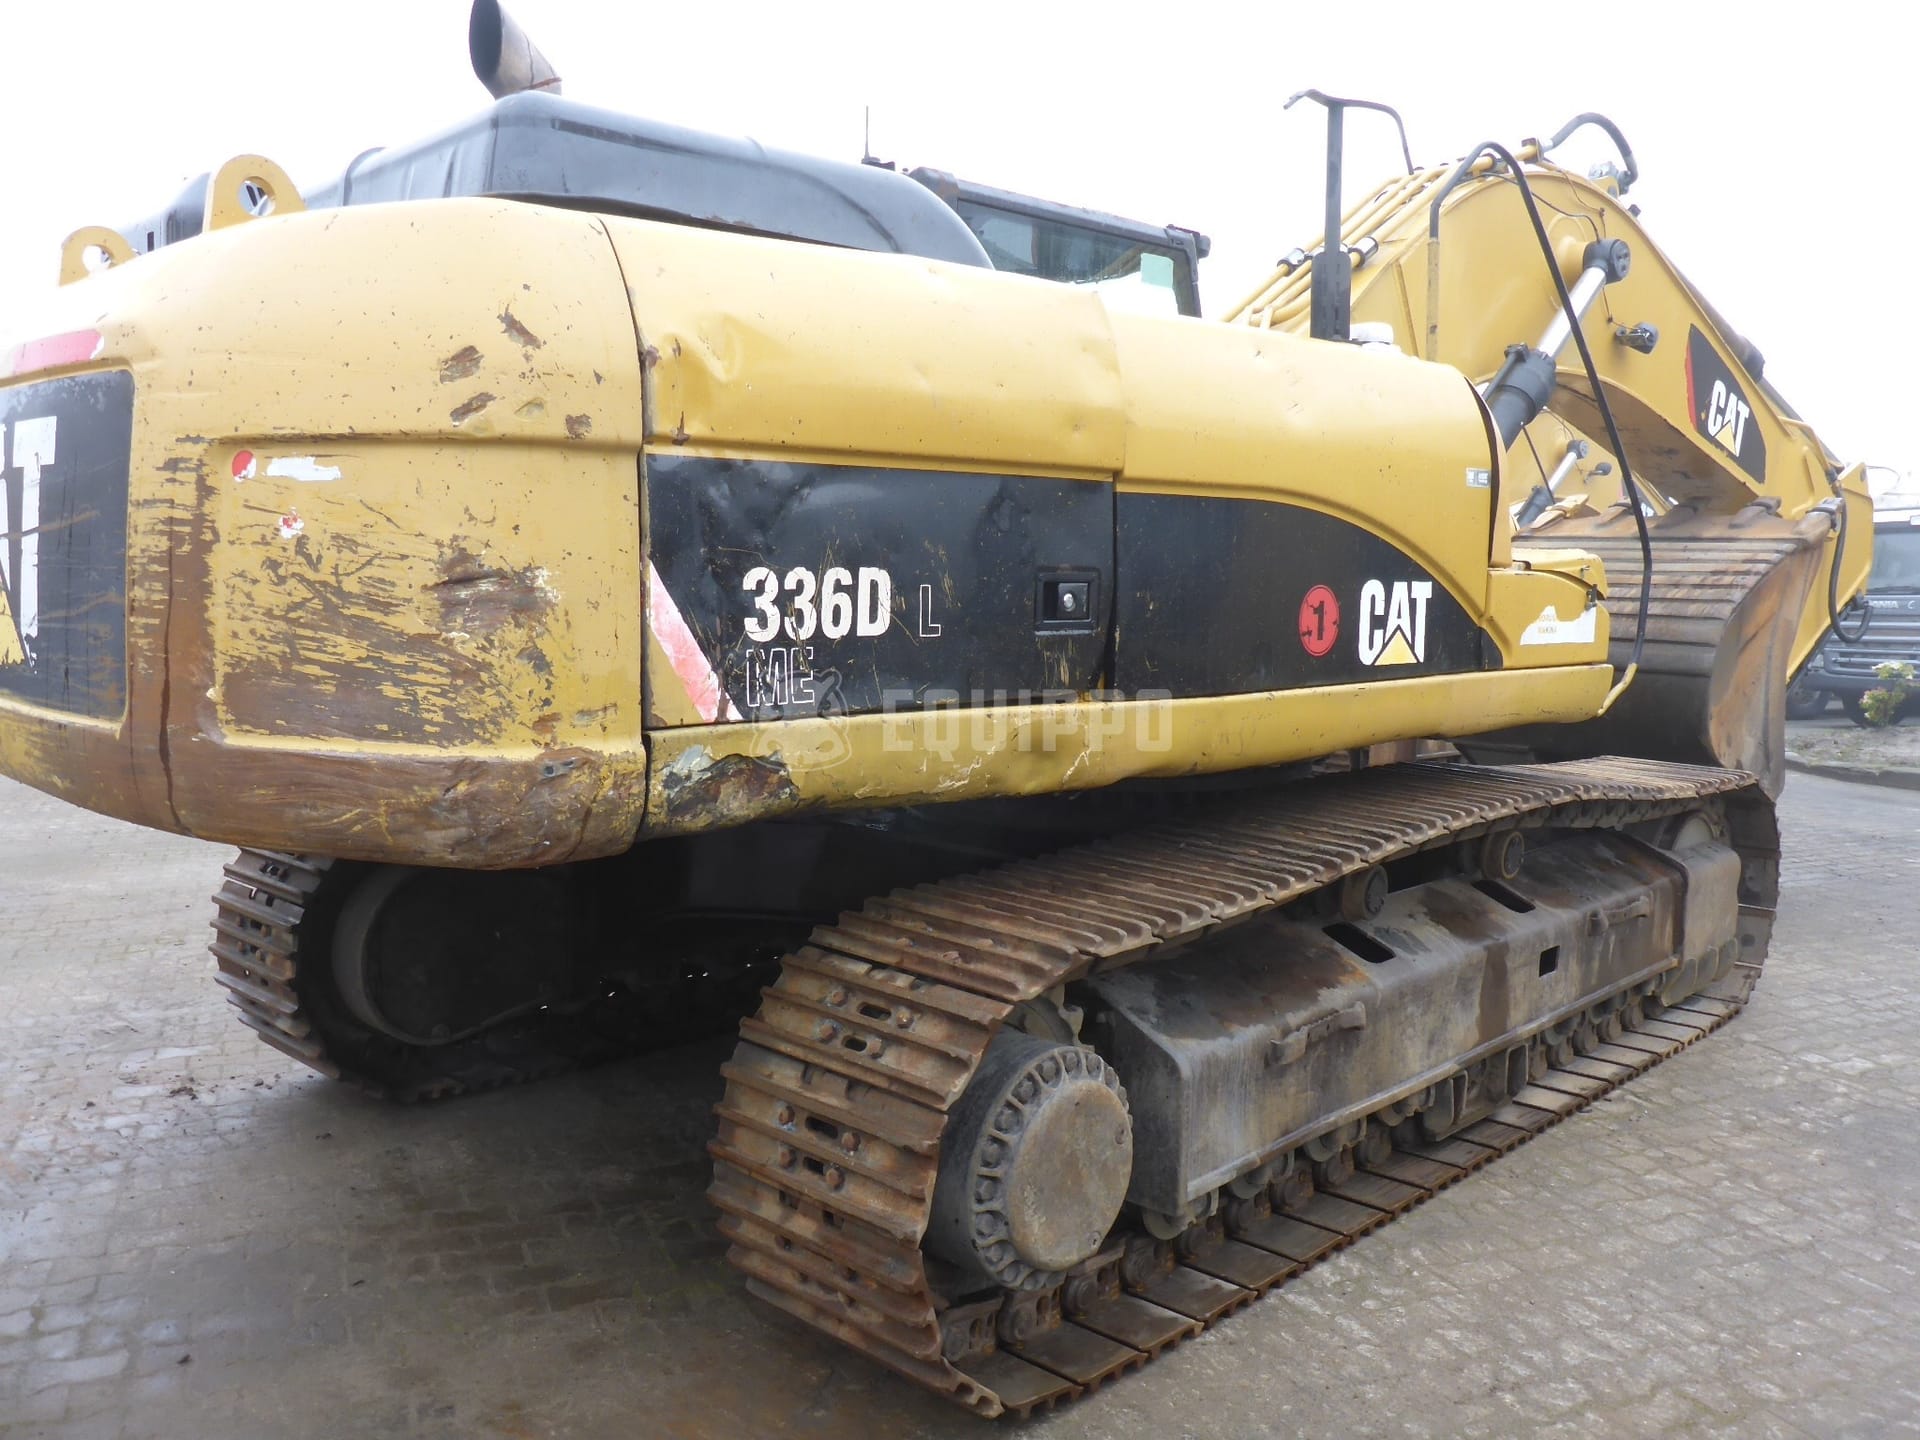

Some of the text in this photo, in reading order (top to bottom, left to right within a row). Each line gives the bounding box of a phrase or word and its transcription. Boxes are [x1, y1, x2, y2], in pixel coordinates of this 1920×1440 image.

[1708, 379, 1750, 457] CAT
[0, 415, 57, 668] T
[743, 566, 942, 643] 336D L
[1358, 579, 1433, 665] CAT
[746, 646, 815, 707] ME
